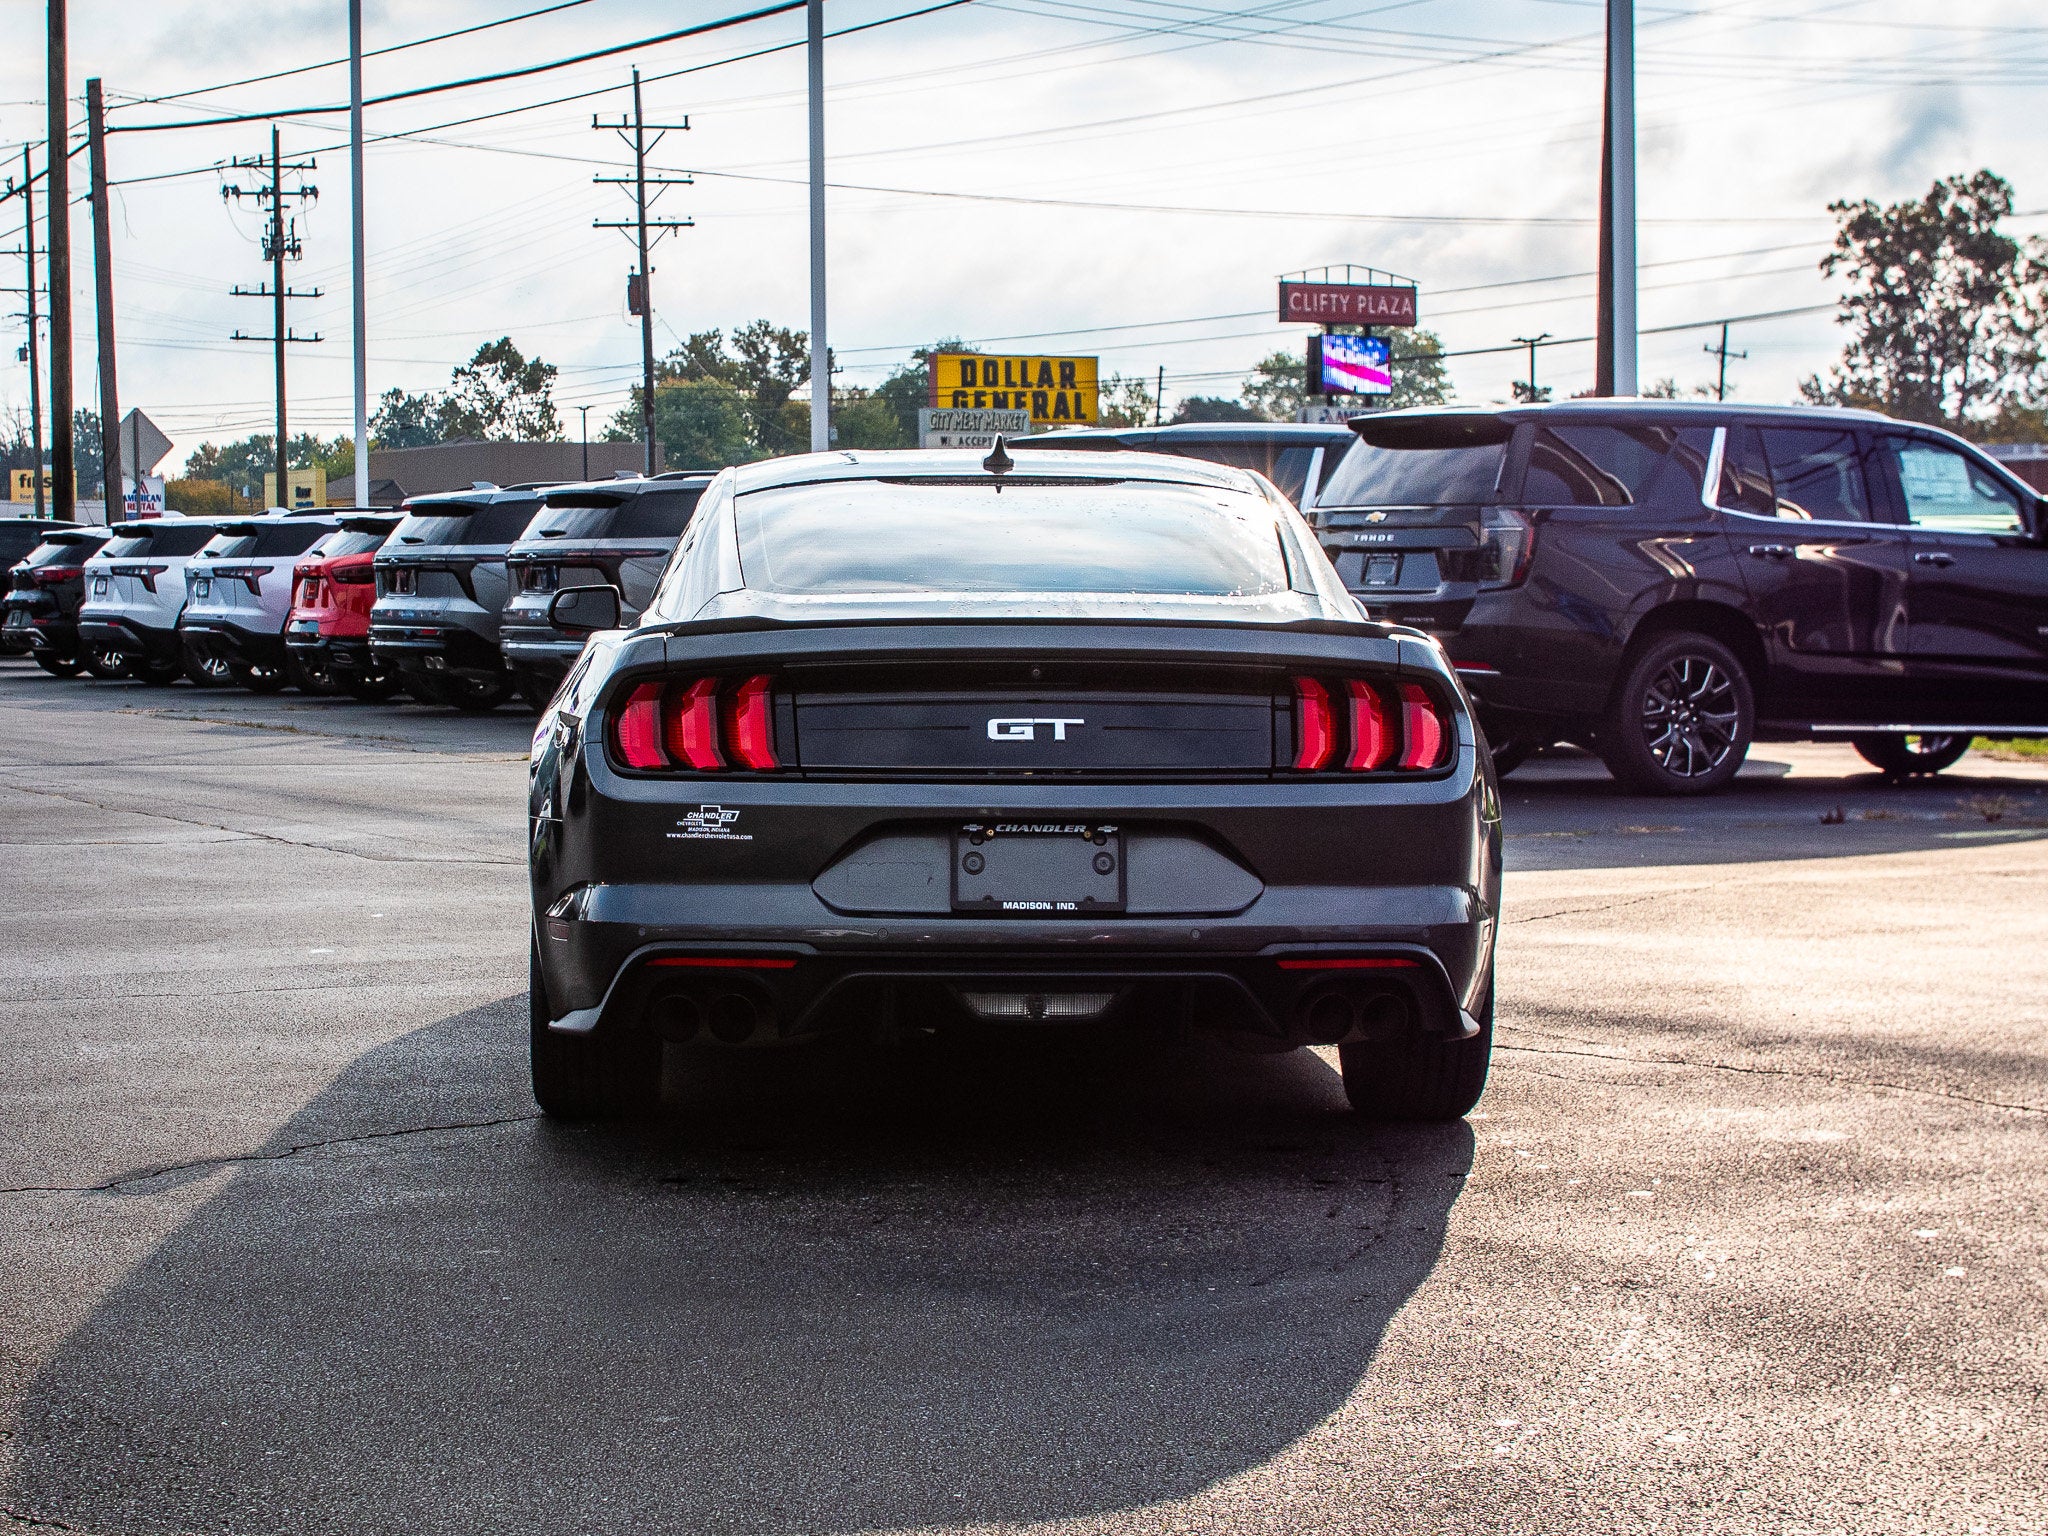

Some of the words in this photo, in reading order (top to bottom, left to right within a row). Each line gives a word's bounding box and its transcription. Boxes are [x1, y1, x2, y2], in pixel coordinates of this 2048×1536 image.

[1288, 291, 1350, 314] CLIFTY
[1357, 294, 1414, 316] PLAZA
[960, 358, 1078, 389] DOLLAR
[952, 389, 1087, 420] GENERAL
[930, 411, 953, 431] CITY
[953, 411, 983, 431] MEAT
[984, 412, 1027, 432] MARKET
[959, 437, 992, 447] ACCEPT
[1353, 534, 1395, 542] TAHOE
[987, 718, 1085, 741] GT
[687, 812, 732, 820] CHANDLER
[995, 824, 1087, 833] CHANDLER
[1057, 902, 1078, 911] IND.
